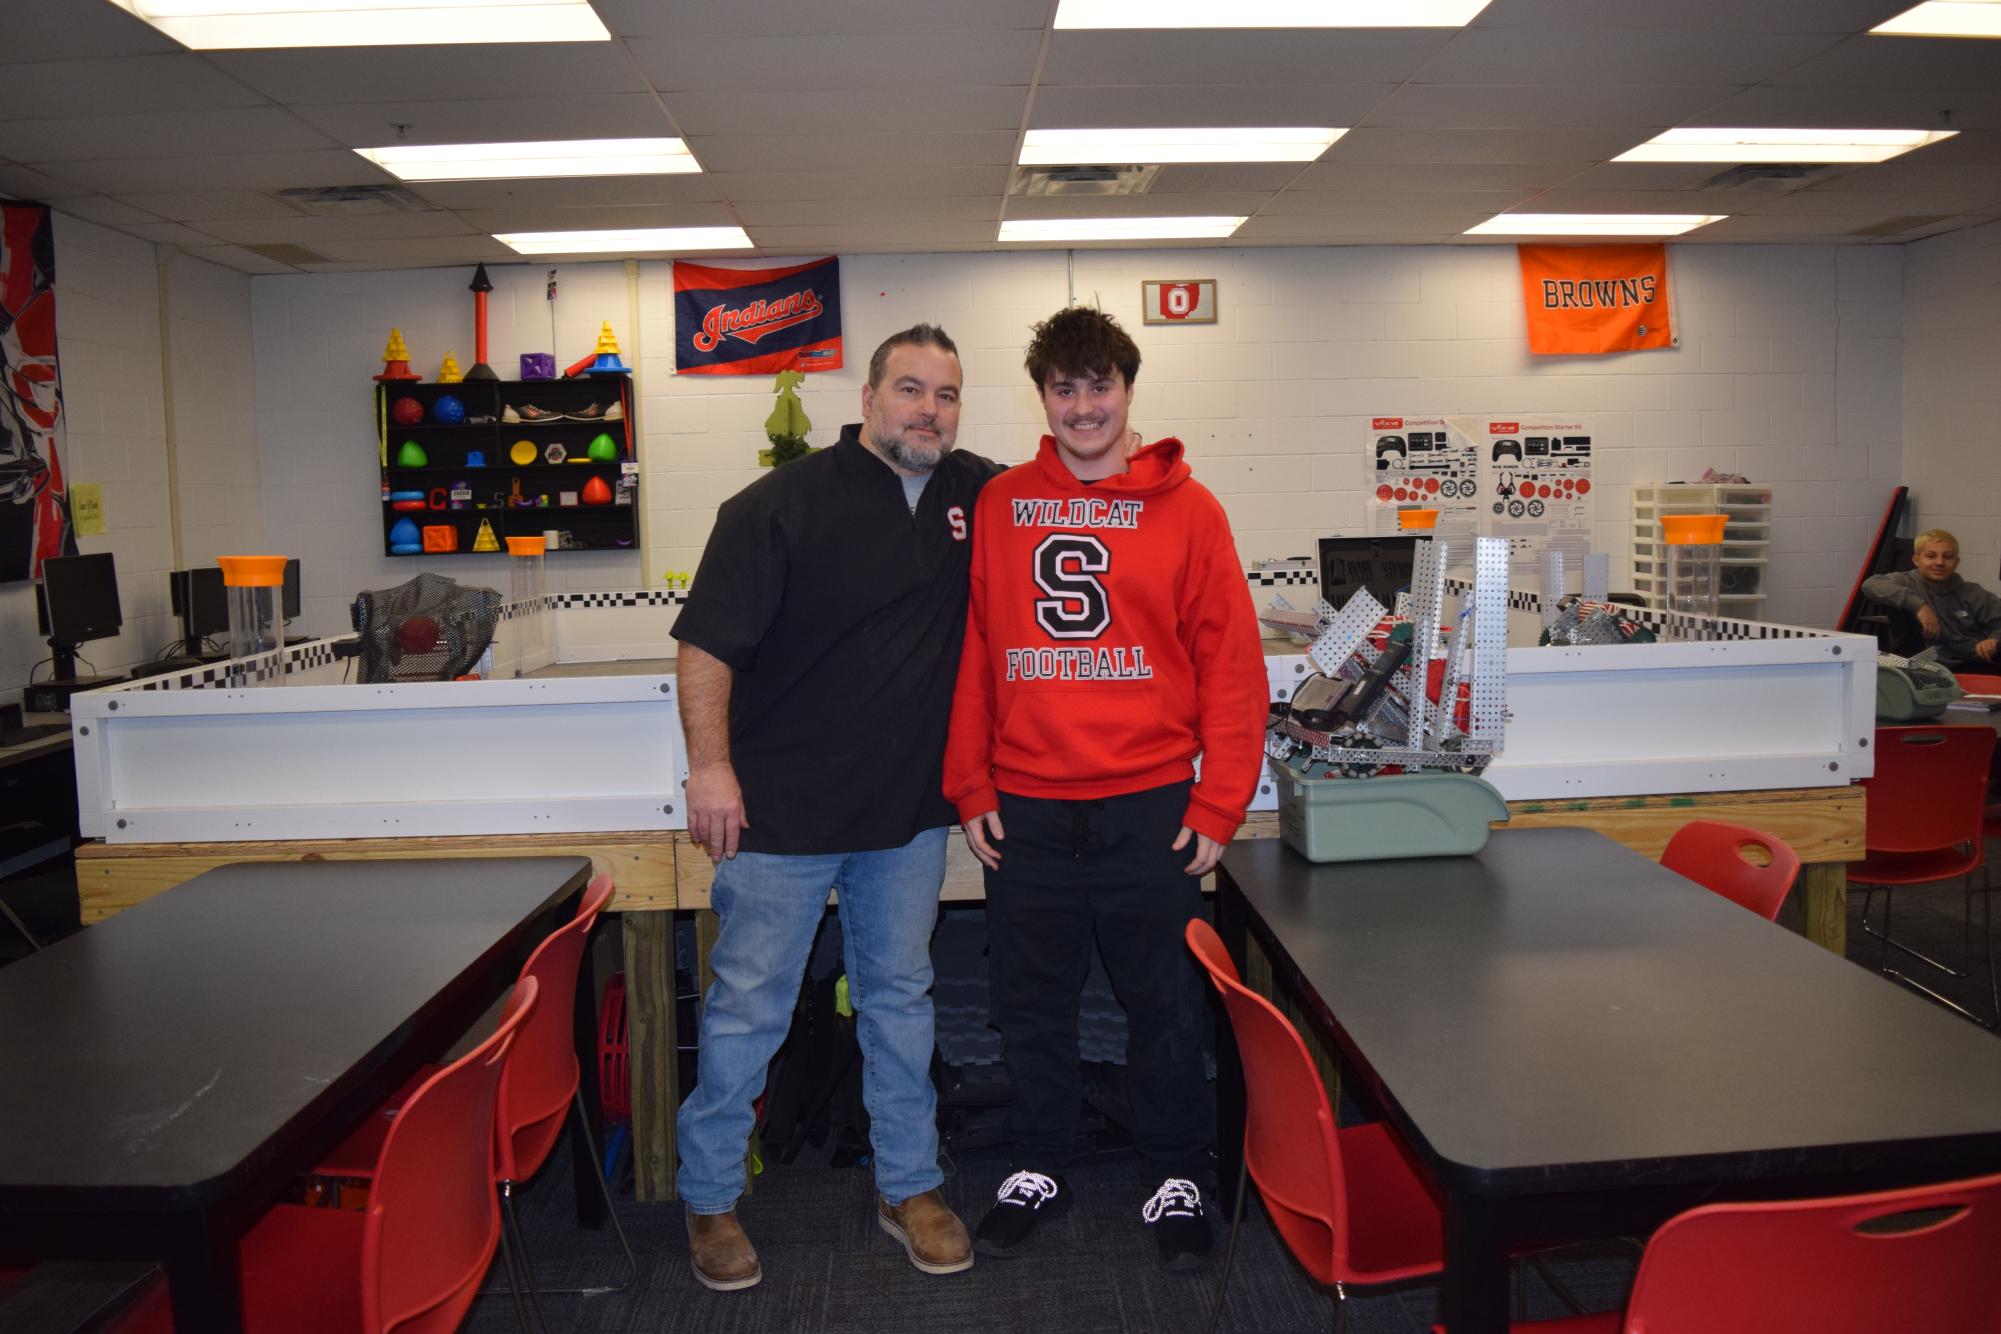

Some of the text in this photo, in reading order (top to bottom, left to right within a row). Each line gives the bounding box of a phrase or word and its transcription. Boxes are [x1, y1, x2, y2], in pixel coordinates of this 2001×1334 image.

[1168, 288, 1189, 314] O
[1543, 275, 1656, 309] BROWNS
[693, 288, 823, 352] Indians
[1404, 419, 1438, 427] Competition
[947, 506, 967, 540] S
[1012, 498, 1143, 529] WILDCAT
[1032, 531, 1112, 641] S
[1006, 646, 1153, 681] FOOTBALL
